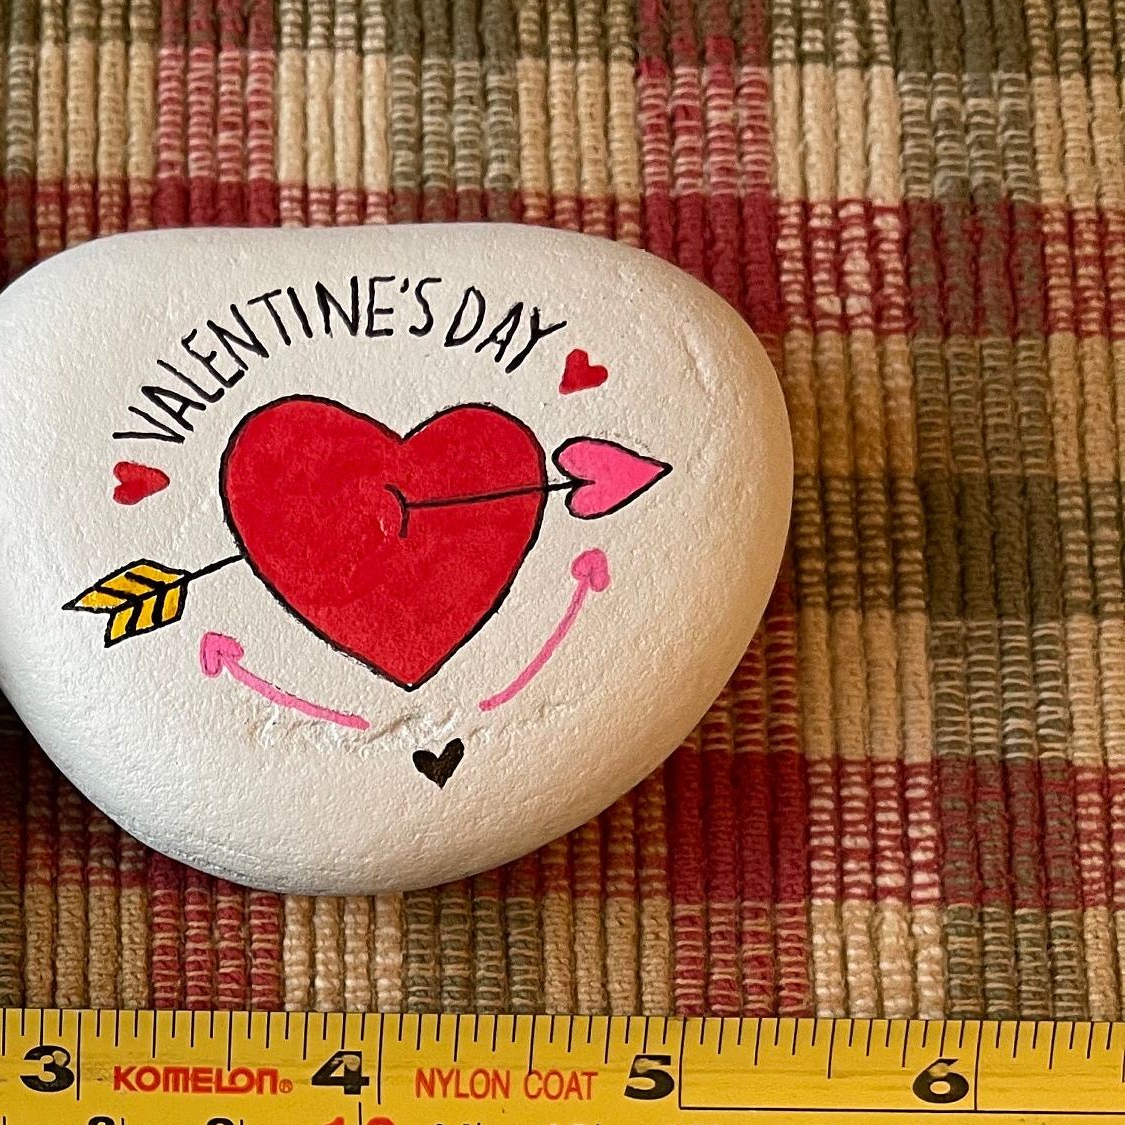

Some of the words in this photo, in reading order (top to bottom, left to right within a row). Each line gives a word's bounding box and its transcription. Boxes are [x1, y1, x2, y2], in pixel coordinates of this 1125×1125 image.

[113, 275, 441, 444] VALENTINE'S
[444, 286, 567, 373] DAY
[20, 1045, 75, 1093] 3
[311, 1050, 370, 1095] 4
[415, 1068, 510, 1100] NYLON
[523, 1069, 598, 1101] COAT
[623, 1054, 675, 1100] 5
[911, 1057, 970, 1104] 6
